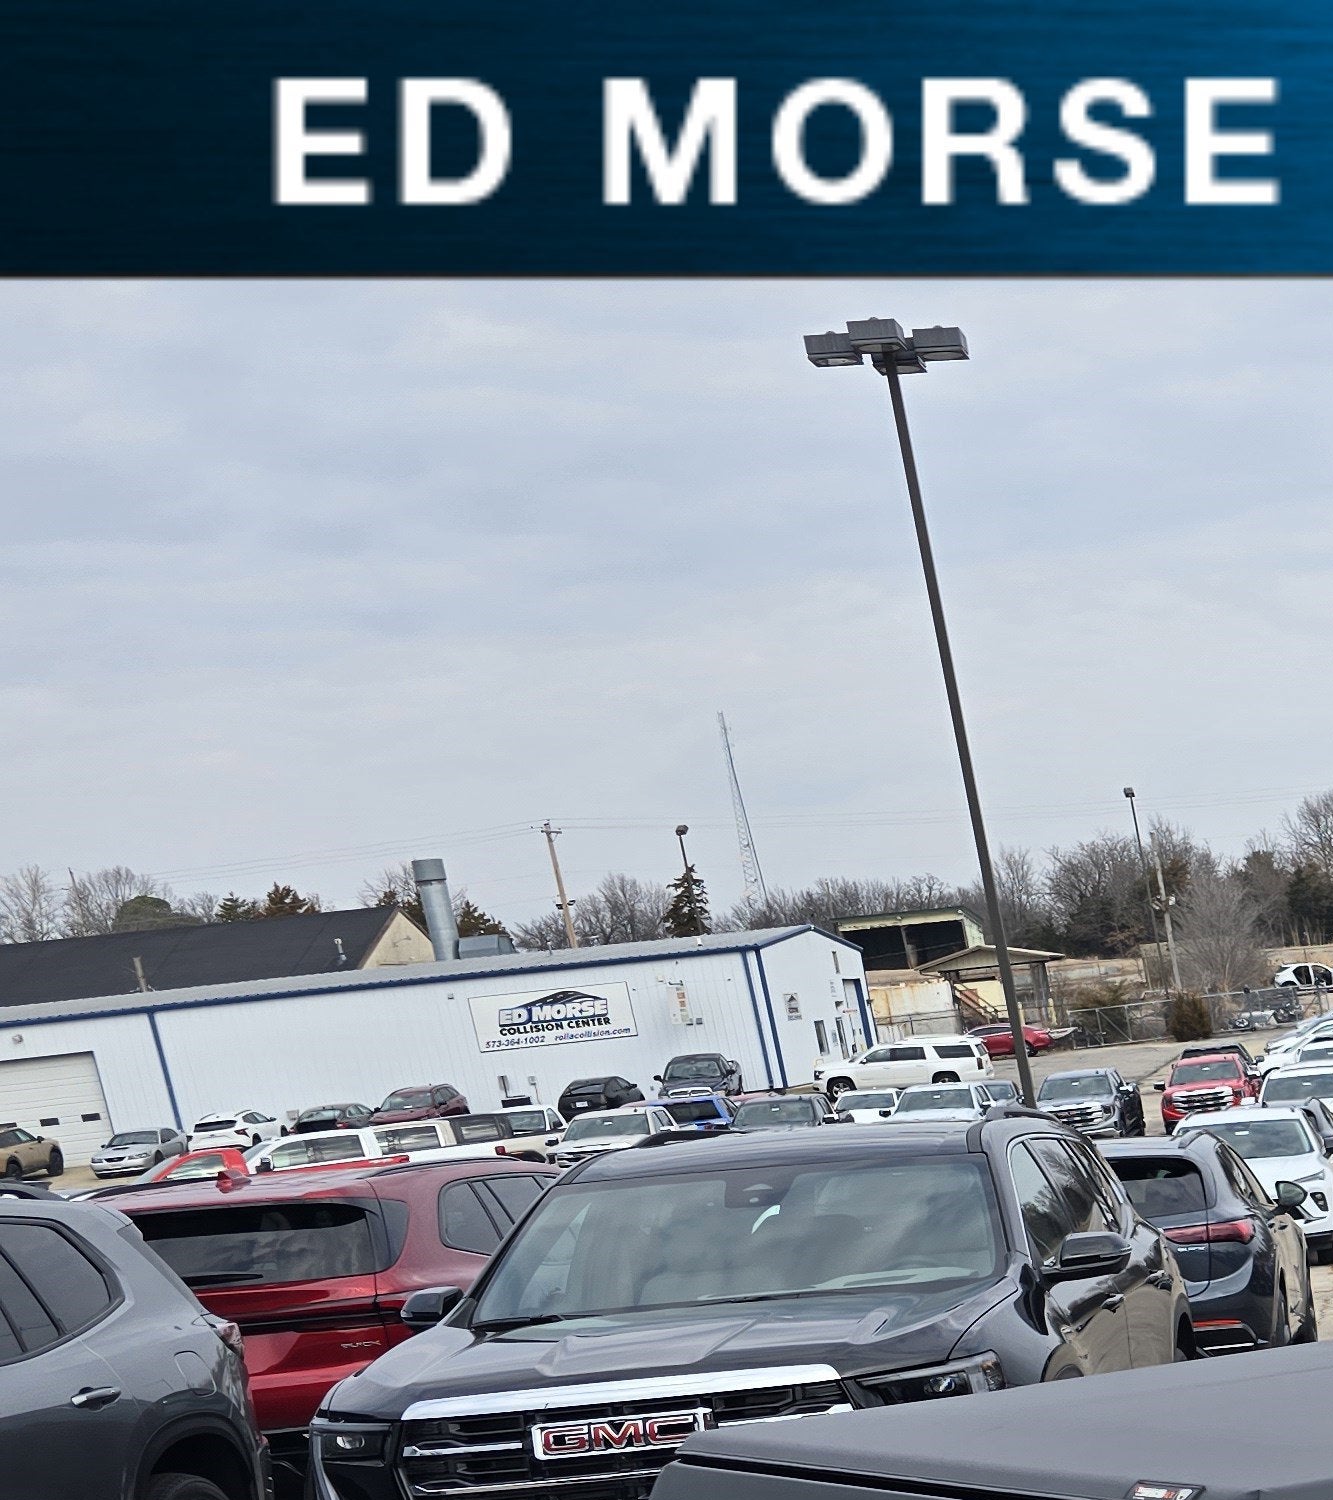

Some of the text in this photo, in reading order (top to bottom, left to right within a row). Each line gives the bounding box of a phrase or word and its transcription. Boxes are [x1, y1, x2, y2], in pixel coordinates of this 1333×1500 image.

[499, 999, 607, 1026] ED MORSE
[499, 1017, 612, 1036] COLLISION CENTER
[486, 1035, 546, 1049] 573-364-1002
[542, 1414, 694, 1456] GMC
